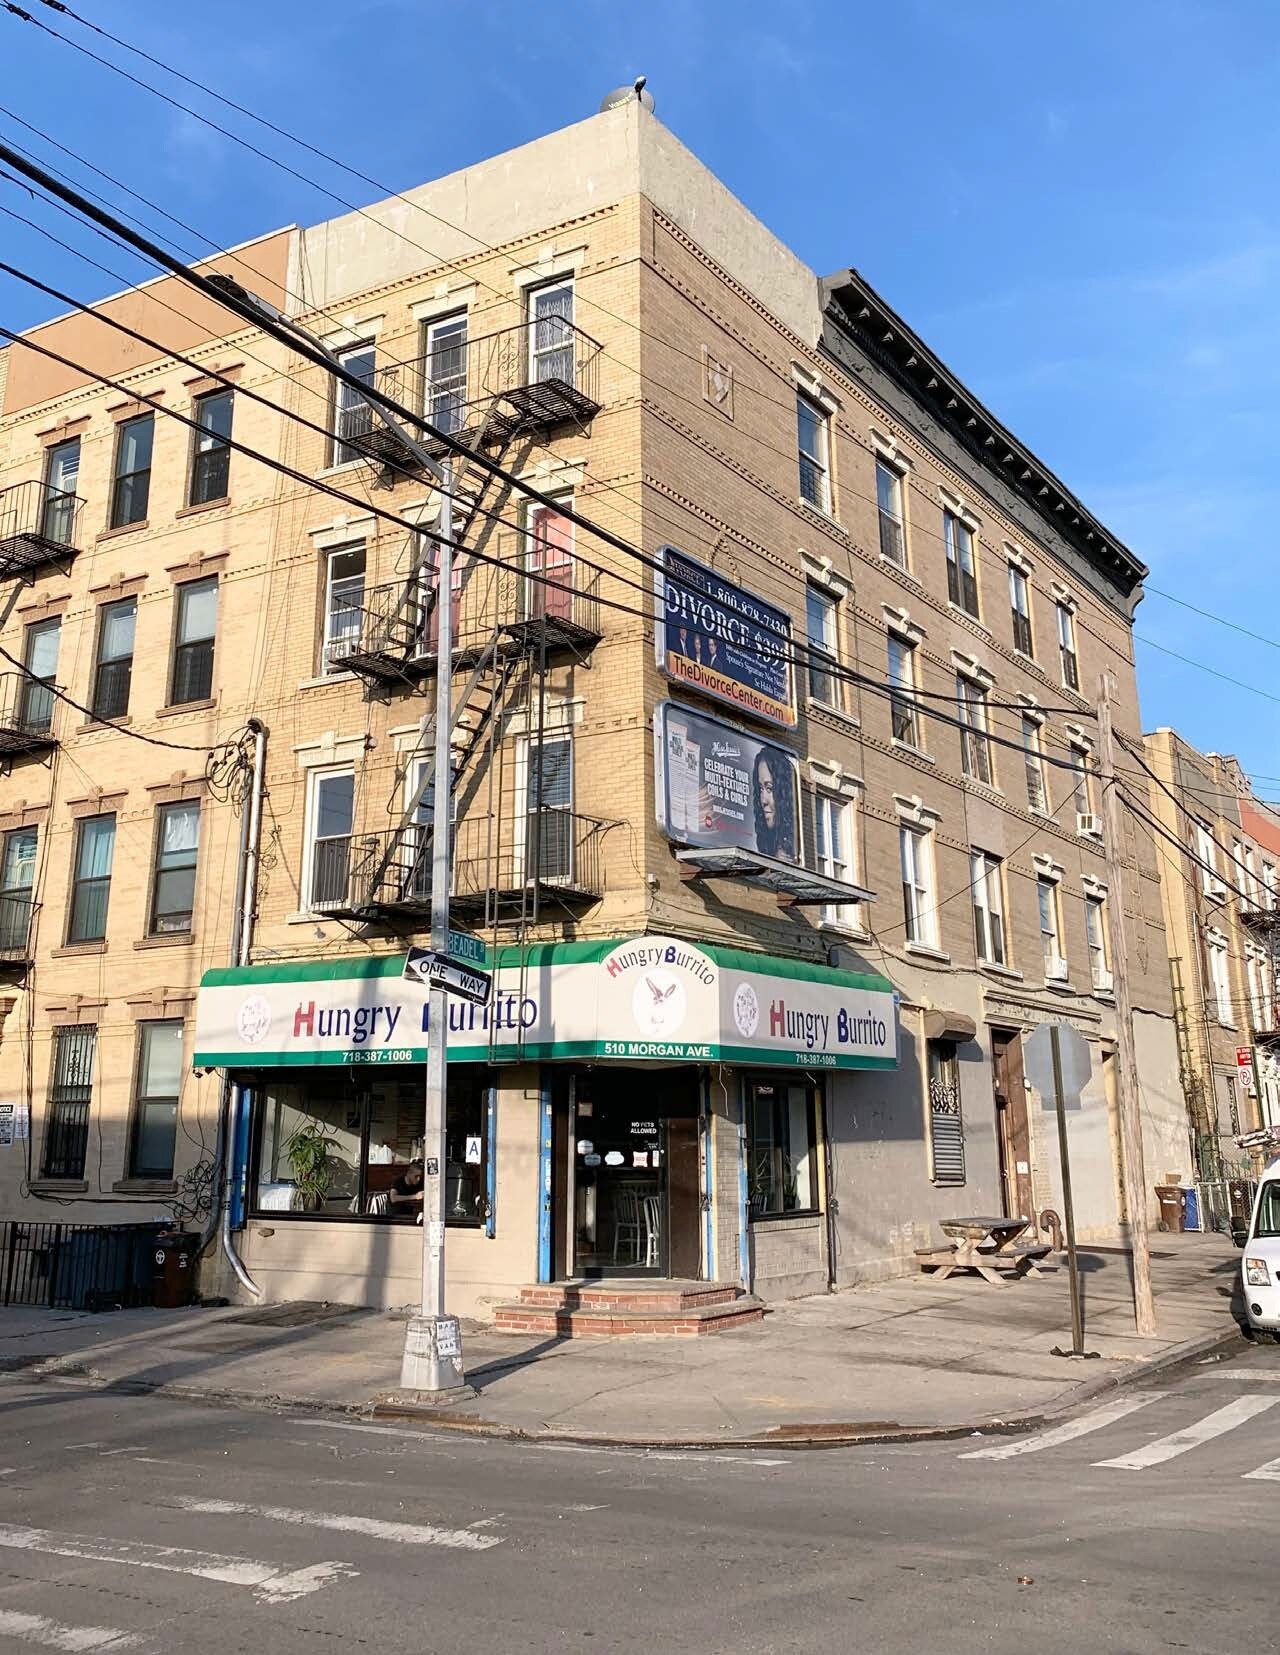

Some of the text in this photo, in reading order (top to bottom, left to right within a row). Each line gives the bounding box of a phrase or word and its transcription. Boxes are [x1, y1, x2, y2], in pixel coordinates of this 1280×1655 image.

[665, 583, 750, 648] DIVORCE
[673, 654, 784, 721] TheDivorceCenter.com
[448, 932, 479, 960] BEADEL
[419, 960, 484, 994] ONE WAY
[606, 945, 716, 985] Hungry Burrito
[293, 991, 538, 1043] Hungry urrito
[769, 999, 887, 1050] Hungry Burrito
[342, 1050, 413, 1063] 718-387-1006
[604, 1042, 714, 1057] 510 MORGAN AVE.
[795, 1053, 837, 1066] 718-387-1006
[469, 1140, 479, 1156] A
